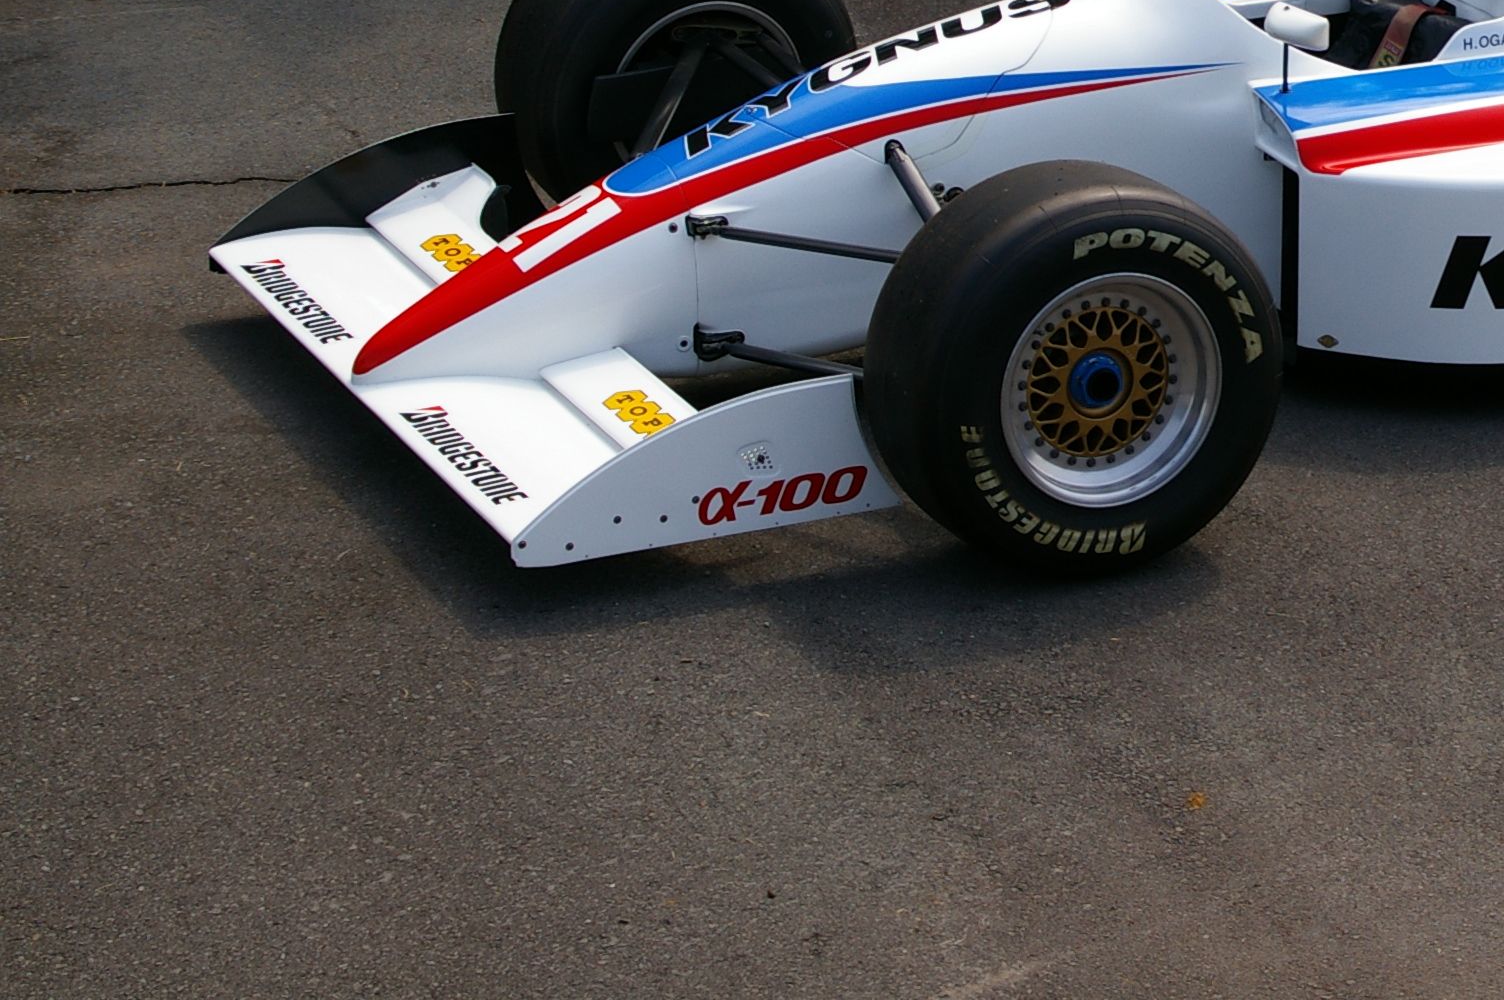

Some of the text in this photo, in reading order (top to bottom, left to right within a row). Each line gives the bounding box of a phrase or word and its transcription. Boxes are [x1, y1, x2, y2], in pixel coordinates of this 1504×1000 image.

[241, 258, 354, 344] BRIDGESTONE
[1073, 227, 1264, 364] POTENZA
[398, 405, 529, 505] BRIDGESTONE
[960, 424, 1148, 556] BRIDGESTONE
